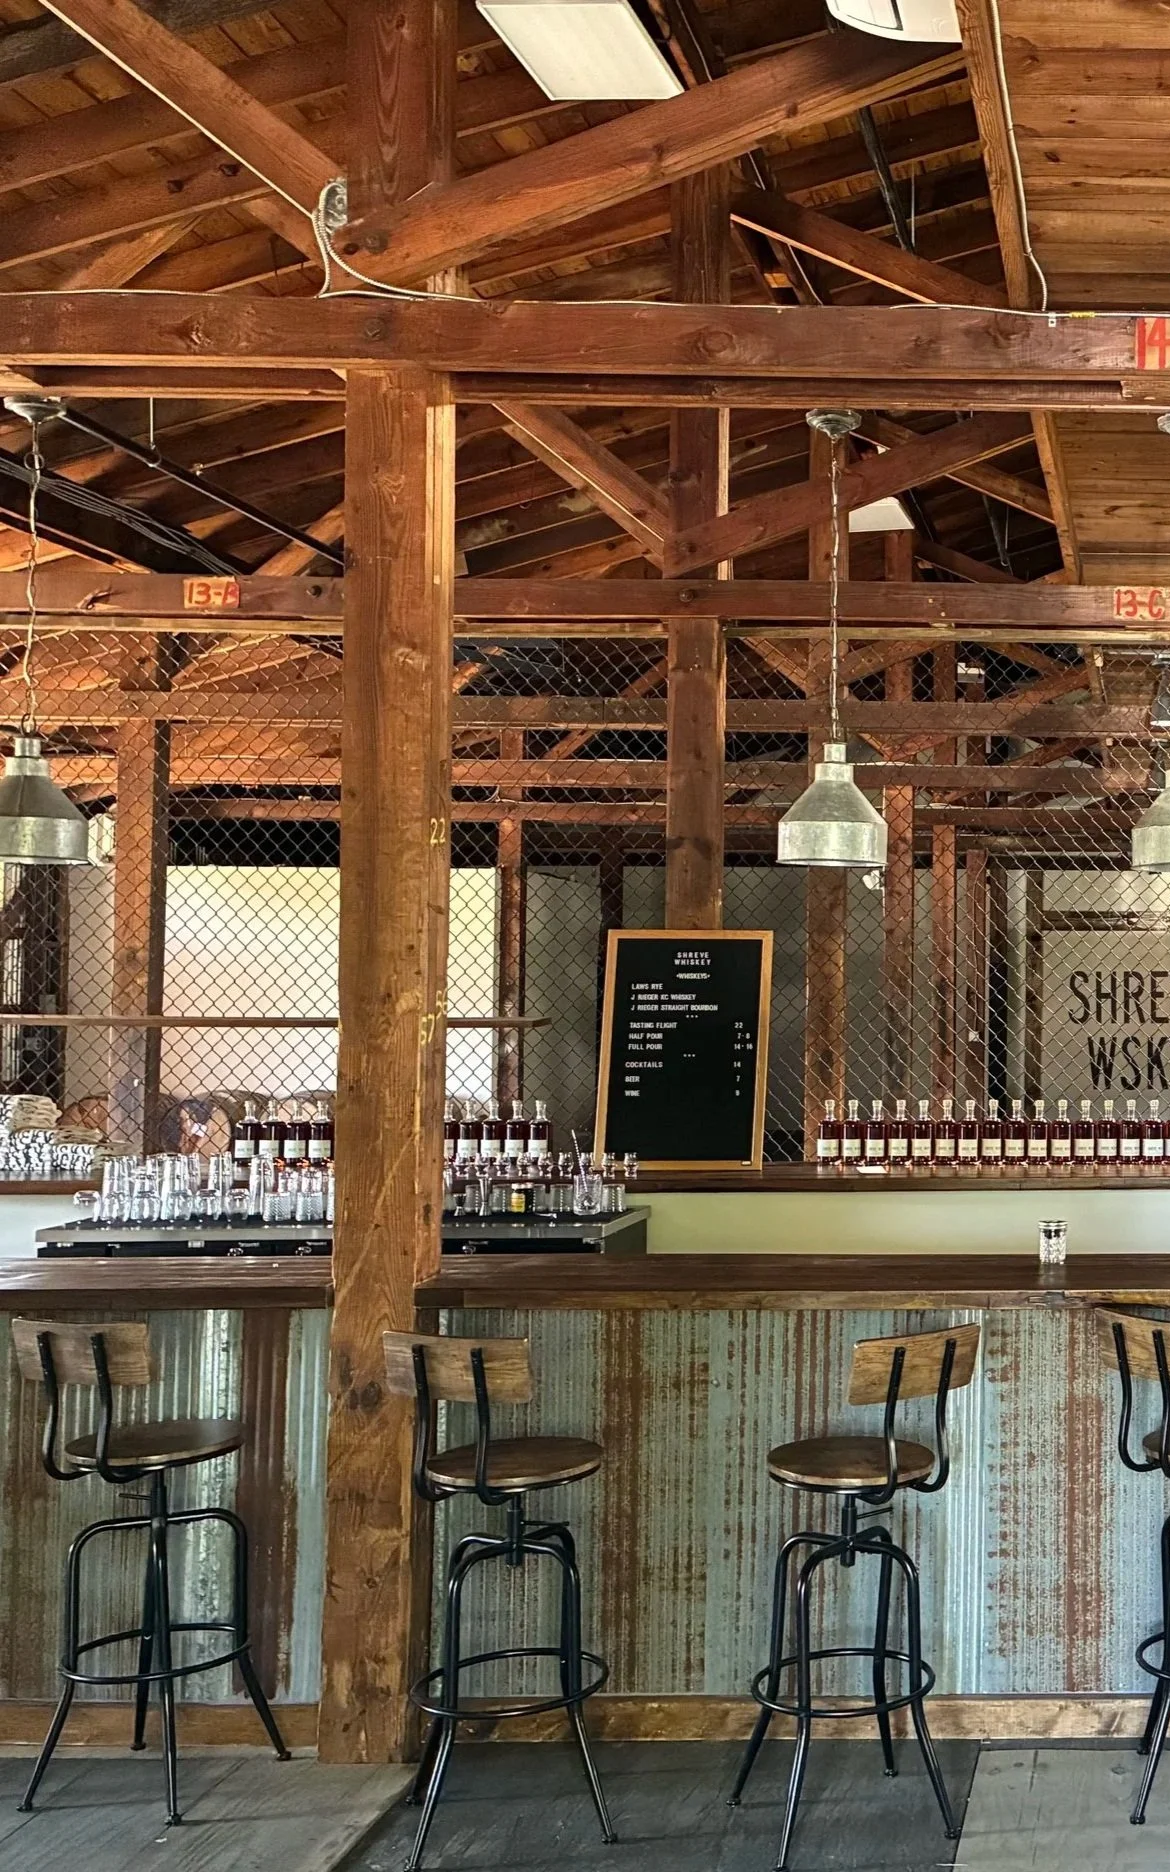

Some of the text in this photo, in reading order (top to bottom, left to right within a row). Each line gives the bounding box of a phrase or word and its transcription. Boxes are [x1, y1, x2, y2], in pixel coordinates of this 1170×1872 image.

[1114, 588, 1164, 619] 13-C
[676, 951, 710, 959] SHREVE
[674, 958, 712, 966] WHISKEY
[631, 983, 664, 991] LAWS RYE
[660, 993, 670, 1001] KC
[670, 993, 697, 1001] WHISKEY
[636, 1004, 659, 1012] RIEGER
[660, 1004, 690, 1012] STRAIGHT
[690, 1004, 719, 1012] BOURBON
[629, 1021, 678, 1029] TASTING FLIGHT
[734, 1021, 744, 1029] 22
[628, 1032, 663, 1040] HALF POUR
[627, 1043, 663, 1051] FULL POUR
[624, 1061, 664, 1069] COCKTAILS
[733, 1061, 742, 1069] 14
[624, 1075, 640, 1083] BEER
[624, 1089, 640, 1097] WINE
